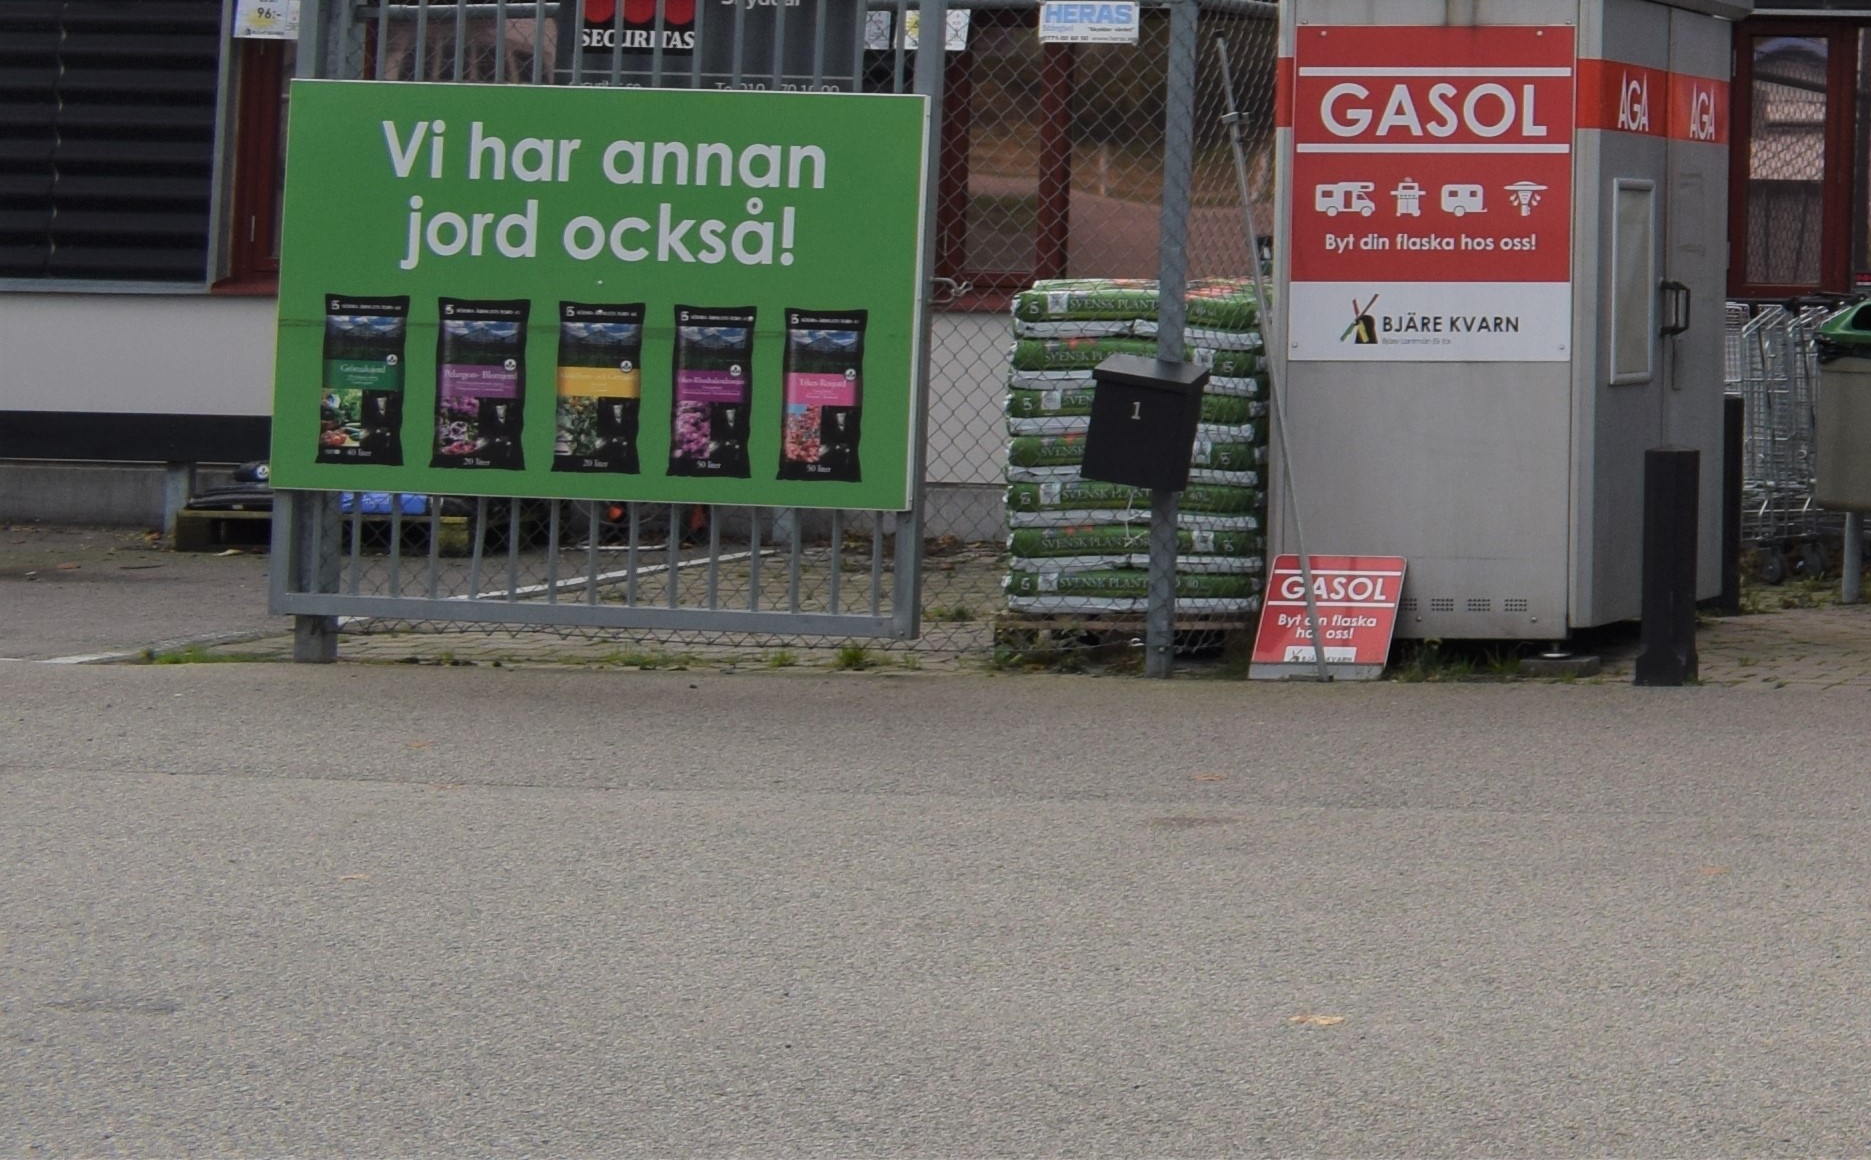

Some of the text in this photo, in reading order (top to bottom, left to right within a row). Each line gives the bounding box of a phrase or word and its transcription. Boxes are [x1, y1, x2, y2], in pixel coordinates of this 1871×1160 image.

[257, 7, 281, 19] 96:-
[1046, 4, 1132, 24] HERAS
[1321, 83, 1546, 137] GASOL
[1618, 69, 1649, 132] AGA
[1690, 80, 1716, 140] AGA
[383, 120, 825, 188] Vi har annan
[400, 196, 795, 269] jord också!
[1326, 234, 1535, 253] Byt din flaska hos oss!
[1383, 313, 1518, 332] BJÄRE KVARN
[1132, 402, 1140, 419] 1
[1281, 576, 1386, 601] GASOL
[1278, 614, 1377, 628] Byt dn flaska
[1326, 628, 1354, 639] oss!
